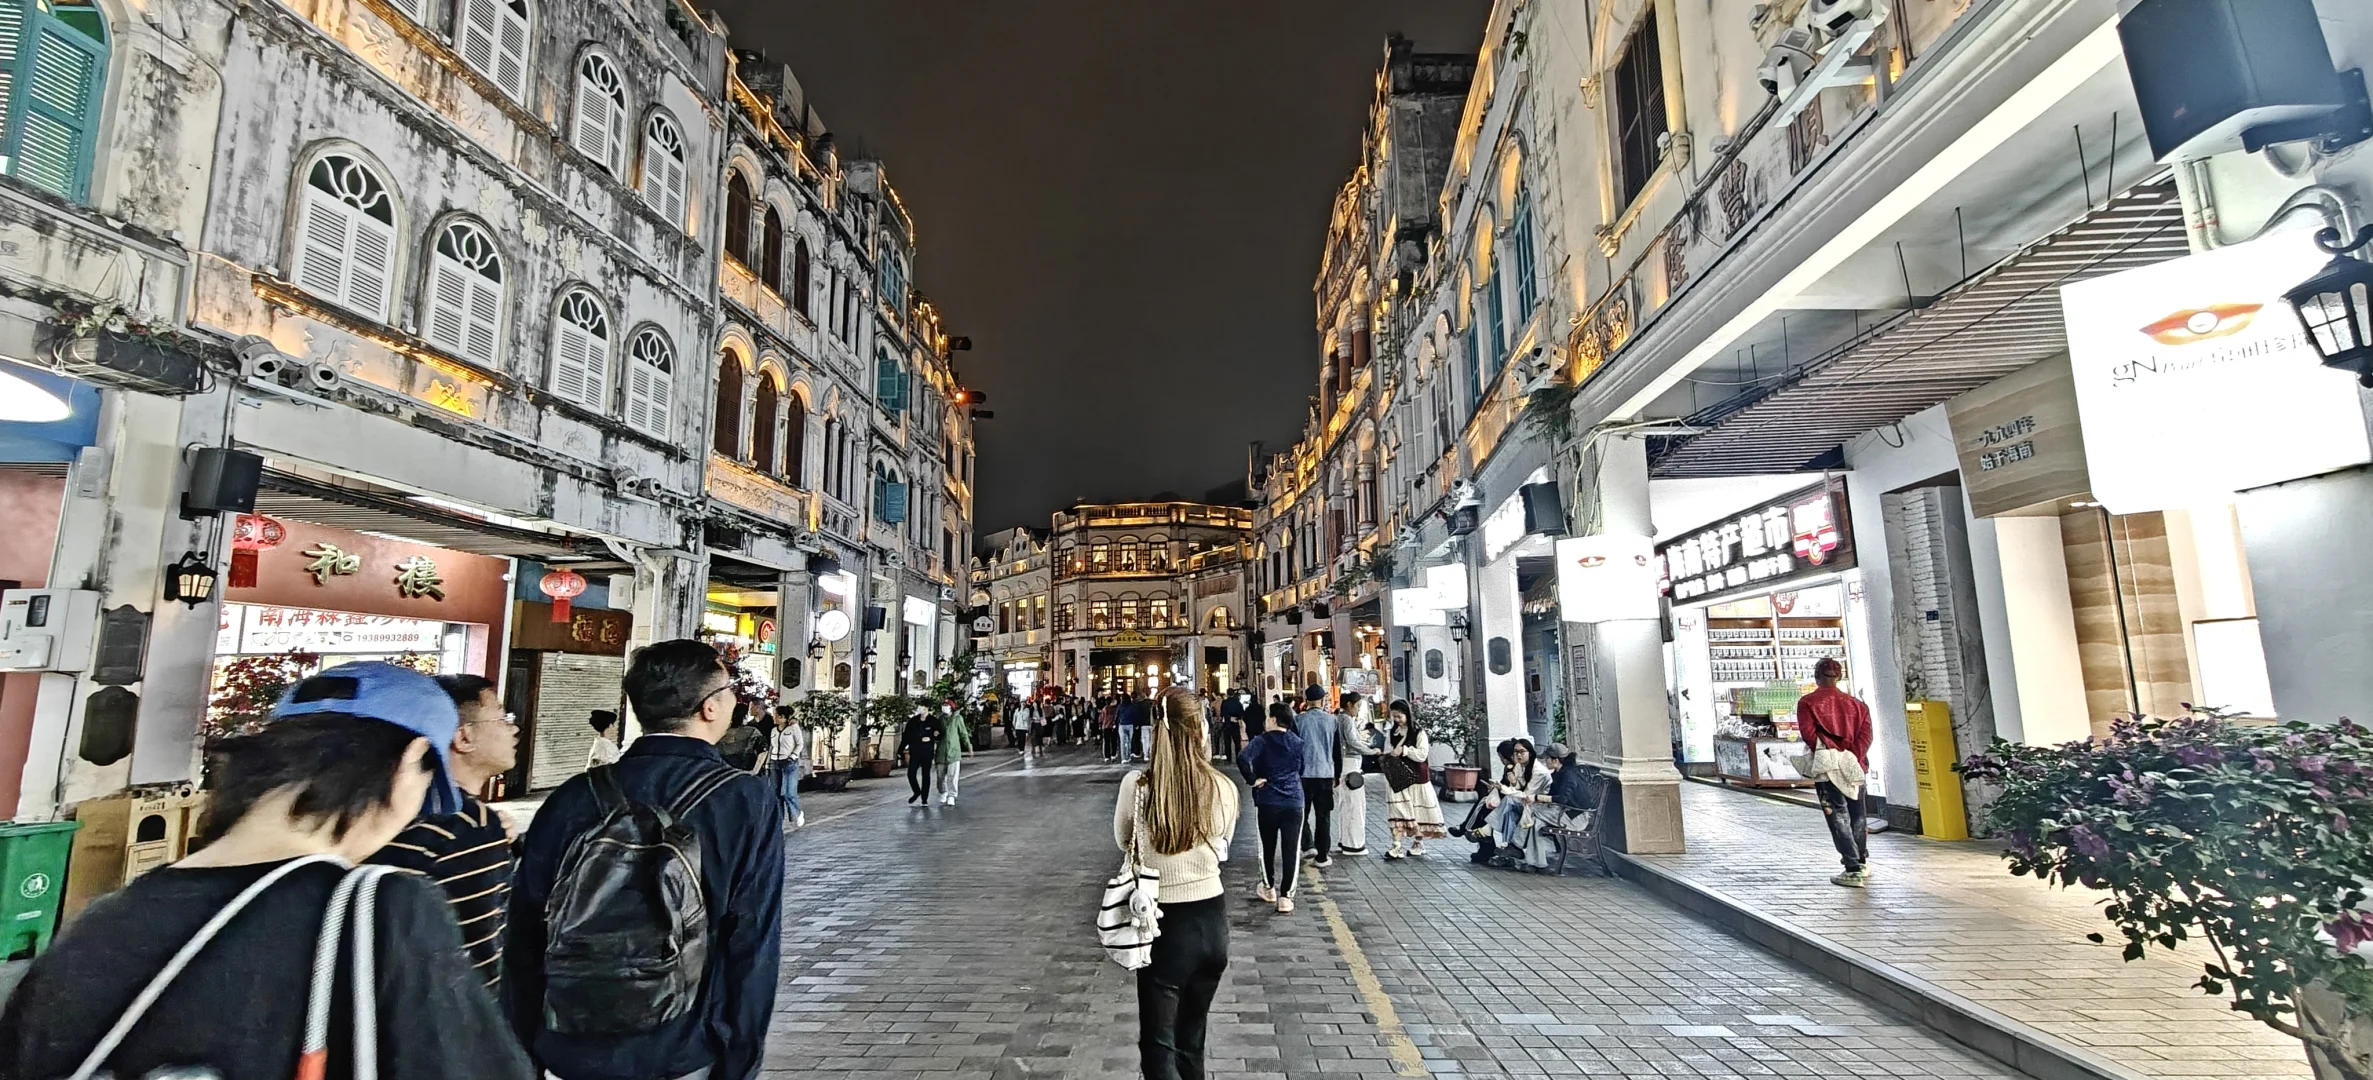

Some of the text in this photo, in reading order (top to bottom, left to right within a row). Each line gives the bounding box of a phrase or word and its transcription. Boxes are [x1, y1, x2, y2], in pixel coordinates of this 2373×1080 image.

[1970, 415, 2036, 448] 一九九四年
[1980, 440, 2035, 471] 始于海南
[1666, 506, 1791, 582] 海南特产超市
[357, 633, 420, 643] 19389932889
